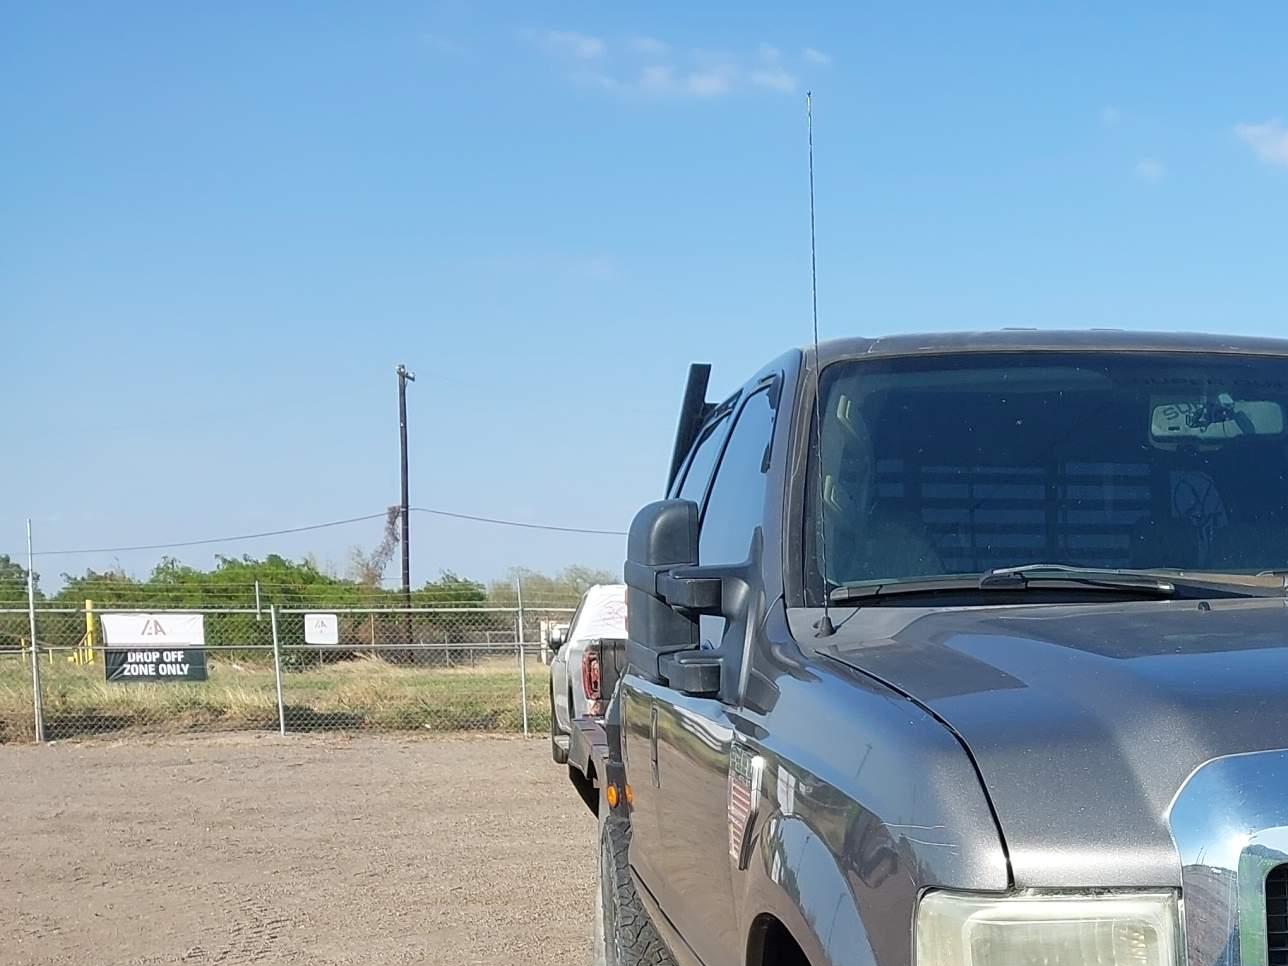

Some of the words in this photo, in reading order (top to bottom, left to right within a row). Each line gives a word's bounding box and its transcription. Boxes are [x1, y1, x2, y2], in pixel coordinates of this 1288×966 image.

[127, 651, 160, 663] DROP
[162, 651, 185, 662] OFF
[123, 663, 156, 676] ZONE
[158, 663, 190, 676] ONLY
